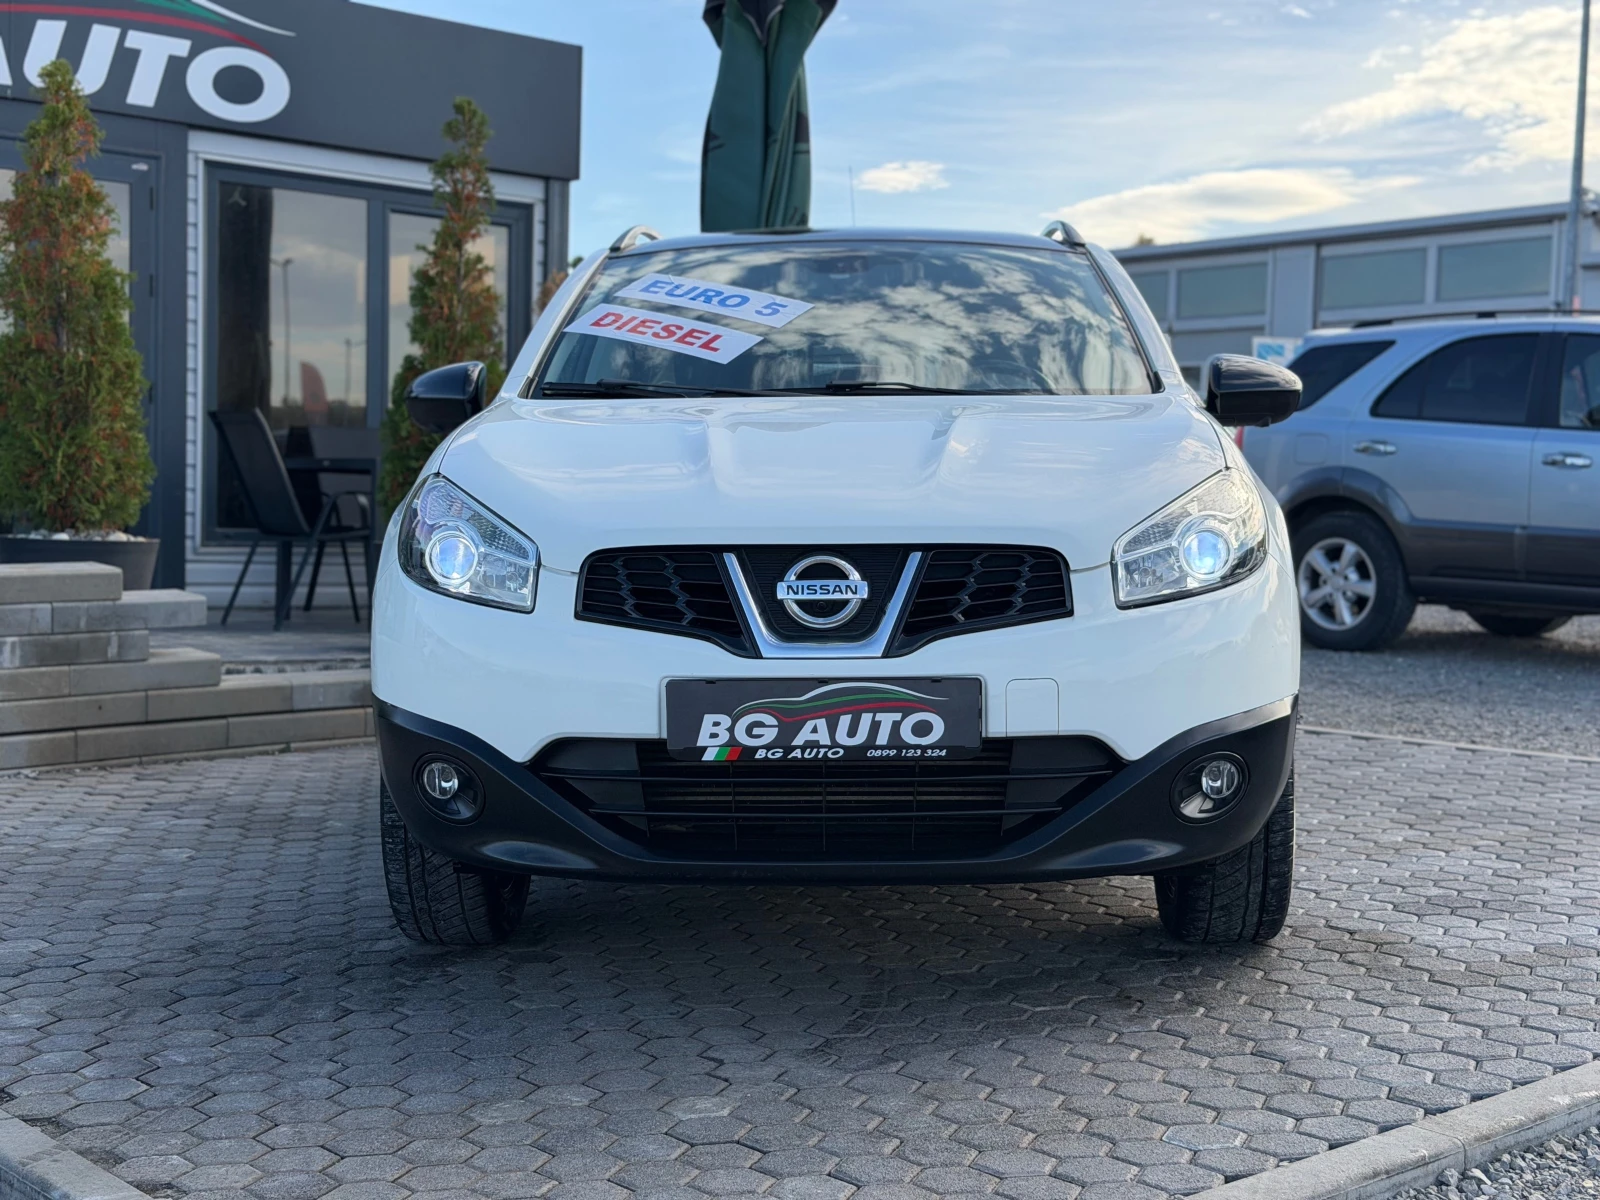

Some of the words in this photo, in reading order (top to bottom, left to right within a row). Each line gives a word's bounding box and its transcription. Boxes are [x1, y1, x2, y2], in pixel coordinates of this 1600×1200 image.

[0, 19, 291, 123] UTO
[639, 279, 751, 309] EURO
[754, 301, 788, 317] 5
[589, 311, 724, 353] DIESEL
[786, 584, 858, 596] NISSAN
[696, 712, 779, 746] BG
[790, 711, 945, 746] AUTO
[754, 748, 784, 759] BG
[787, 748, 845, 759] AUTO
[866, 749, 898, 757] 0899
[901, 749, 922, 757] 123
[924, 749, 947, 757] 324
